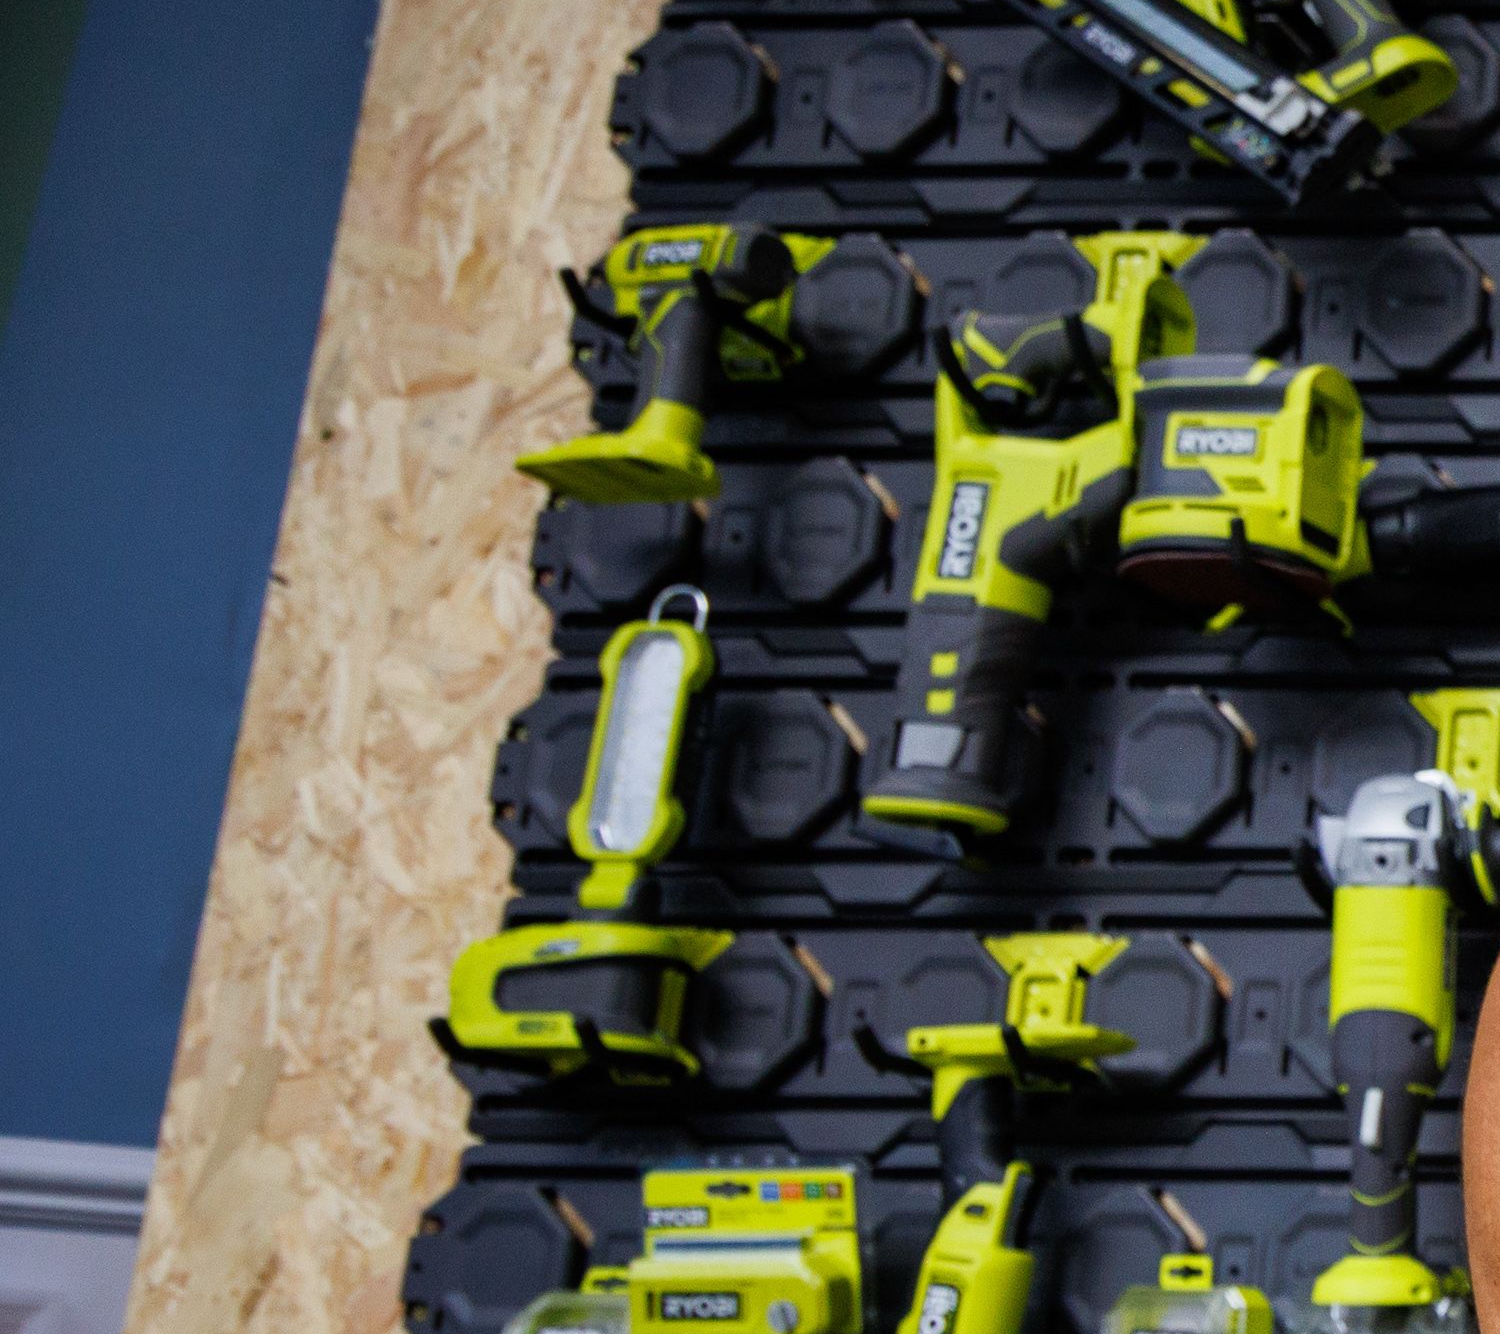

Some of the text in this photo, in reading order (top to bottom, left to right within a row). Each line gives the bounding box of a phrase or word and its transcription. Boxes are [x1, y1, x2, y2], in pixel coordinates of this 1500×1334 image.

[1176, 429, 1257, 454] RYOBI
[938, 484, 989, 578] RYOBI
[663, 1296, 738, 1319] RYOBI
